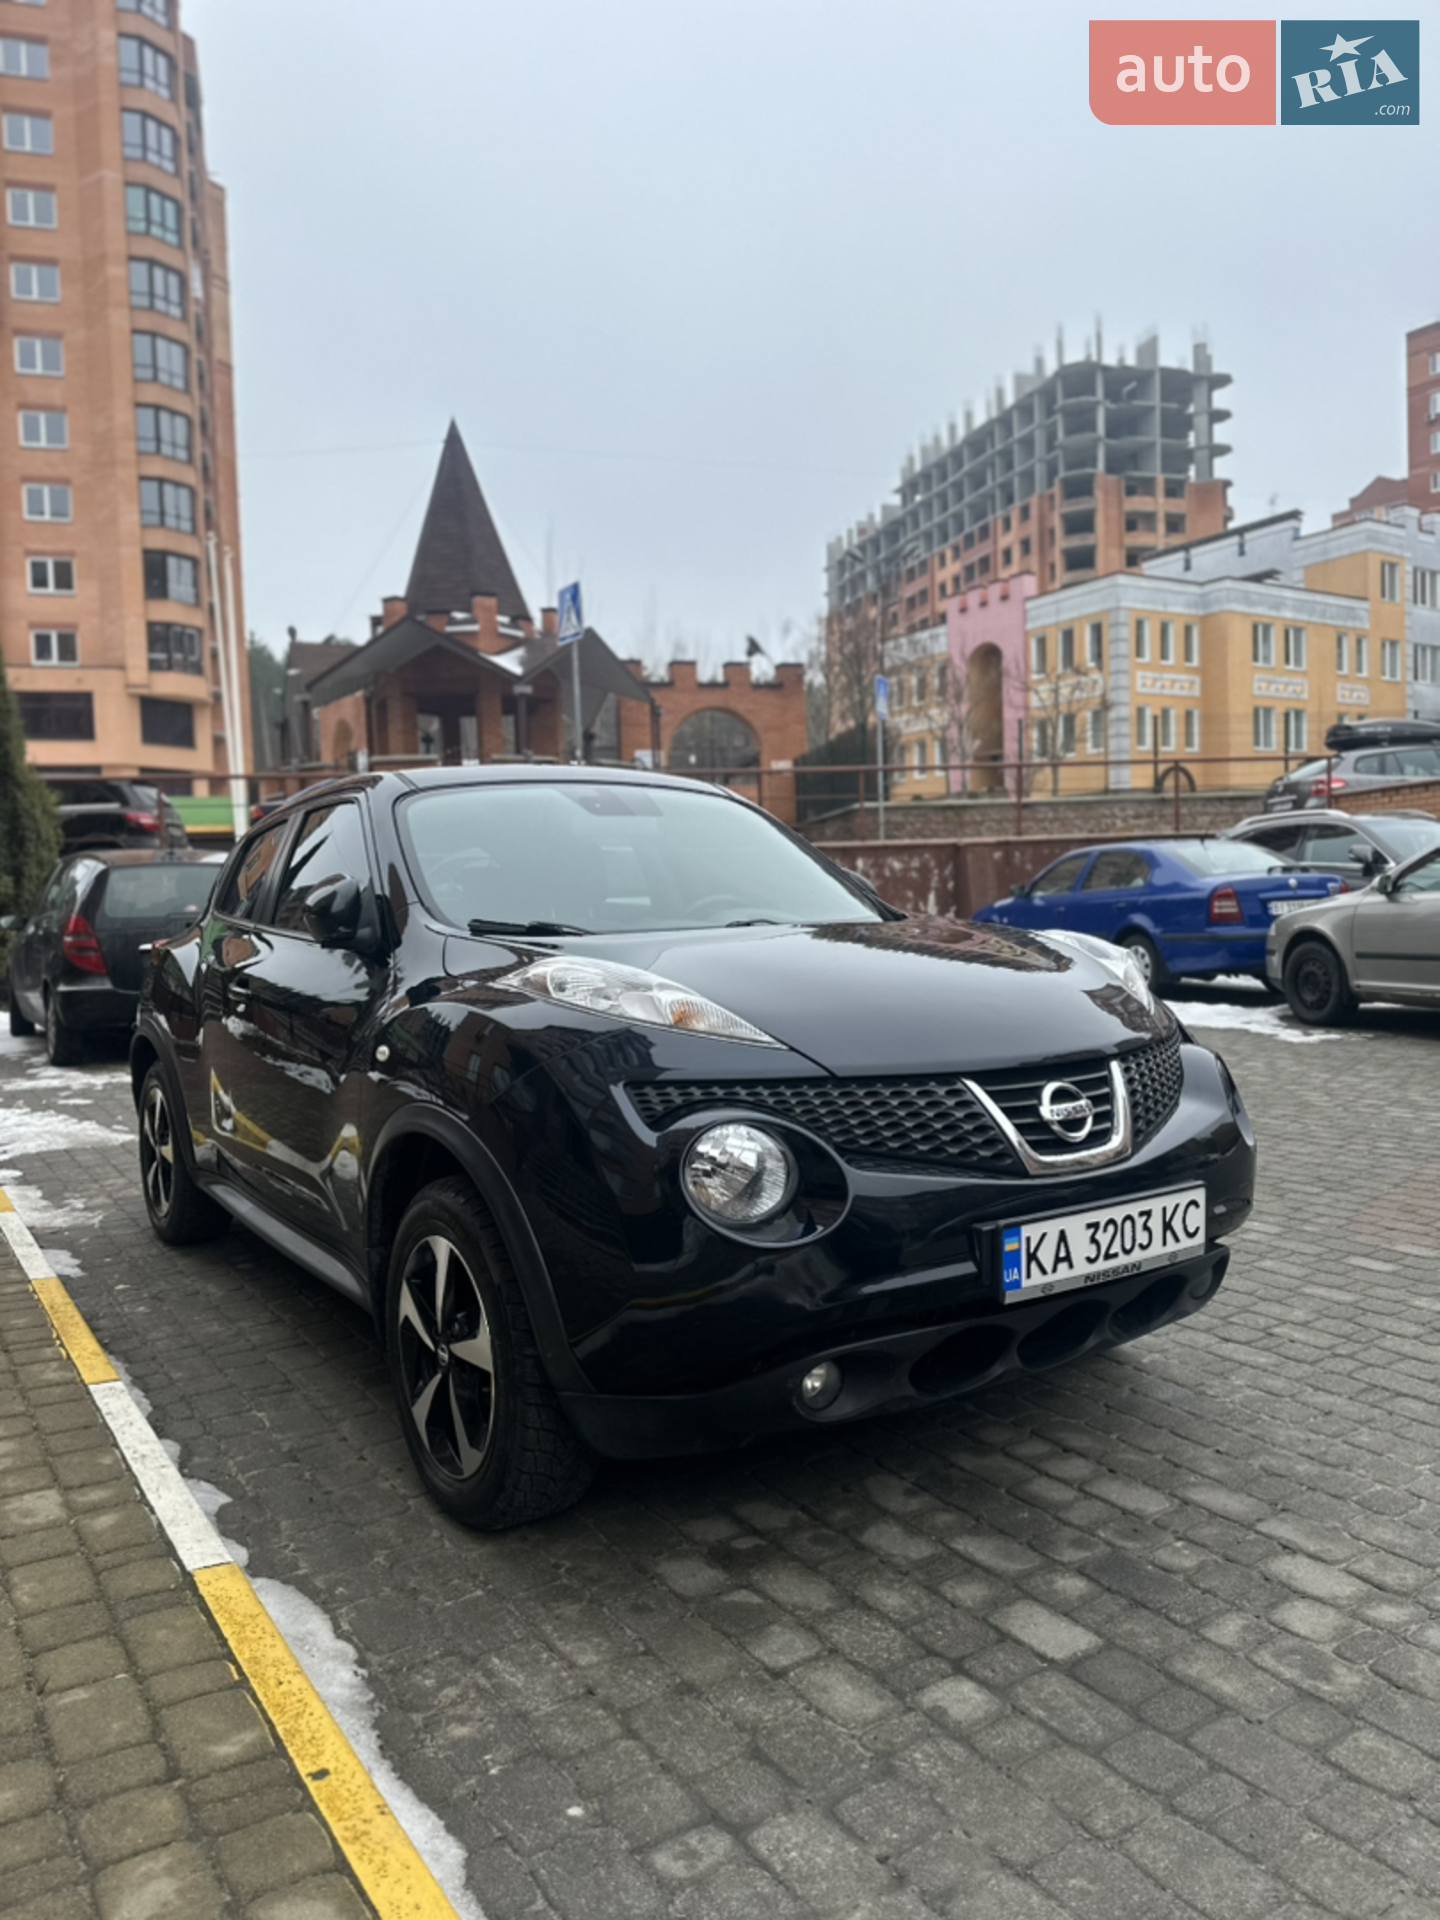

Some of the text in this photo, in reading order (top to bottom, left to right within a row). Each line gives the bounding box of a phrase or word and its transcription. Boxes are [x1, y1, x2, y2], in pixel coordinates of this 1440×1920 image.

[1025, 1200, 1201, 1280] KA 3203 KC
[1004, 1268, 1020, 1283] UA
[1084, 1262, 1142, 1284] NISSAN
